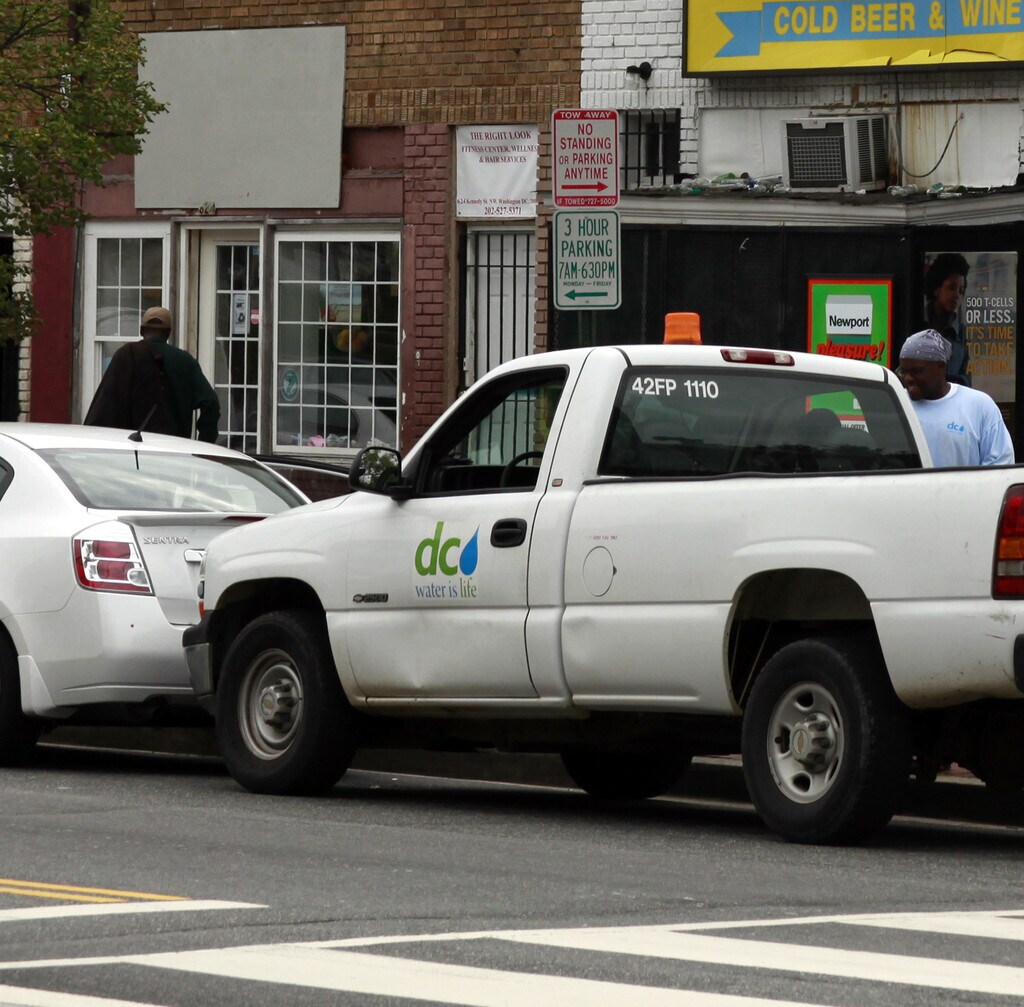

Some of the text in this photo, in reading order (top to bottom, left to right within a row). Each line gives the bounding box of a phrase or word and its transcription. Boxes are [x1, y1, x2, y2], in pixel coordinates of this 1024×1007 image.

[774, 5, 838, 35] COLD
[850, 2, 915, 32] BEER
[928, 1, 944, 31] &
[560, 111, 611, 119] TOW AWAY
[470, 130, 532, 141] THE RIGHT LOOK
[577, 123, 593, 136] NO
[461, 145, 484, 153] FITNESS
[560, 137, 612, 150] STANDING
[485, 155, 500, 163] HAIR
[500, 155, 527, 163] SERVICES
[558, 152, 613, 165] OR PARKING
[564, 167, 608, 179] ANYTIME
[556, 197, 616, 205] IF TOWED 727-5000
[484, 206, 521, 215] 202-527-5371
[564, 218, 609, 237] 3 HOUR
[561, 239, 613, 258] PARKING
[558, 261, 615, 280] 7AM-630PM
[966, 296, 1014, 308] 500 T-CELLS
[828, 315, 870, 330] Newport
[966, 308, 1015, 324] OR LESS.
[966, 325, 1014, 340] IT'S TIME
[966, 341, 1014, 357] TO TAKE
[631, 376, 719, 399] 42FP 1110
[947, 421, 960, 432] dc
[143, 536, 190, 545] SENTRA
[414, 520, 462, 577] dc
[415, 577, 477, 598] water is life
